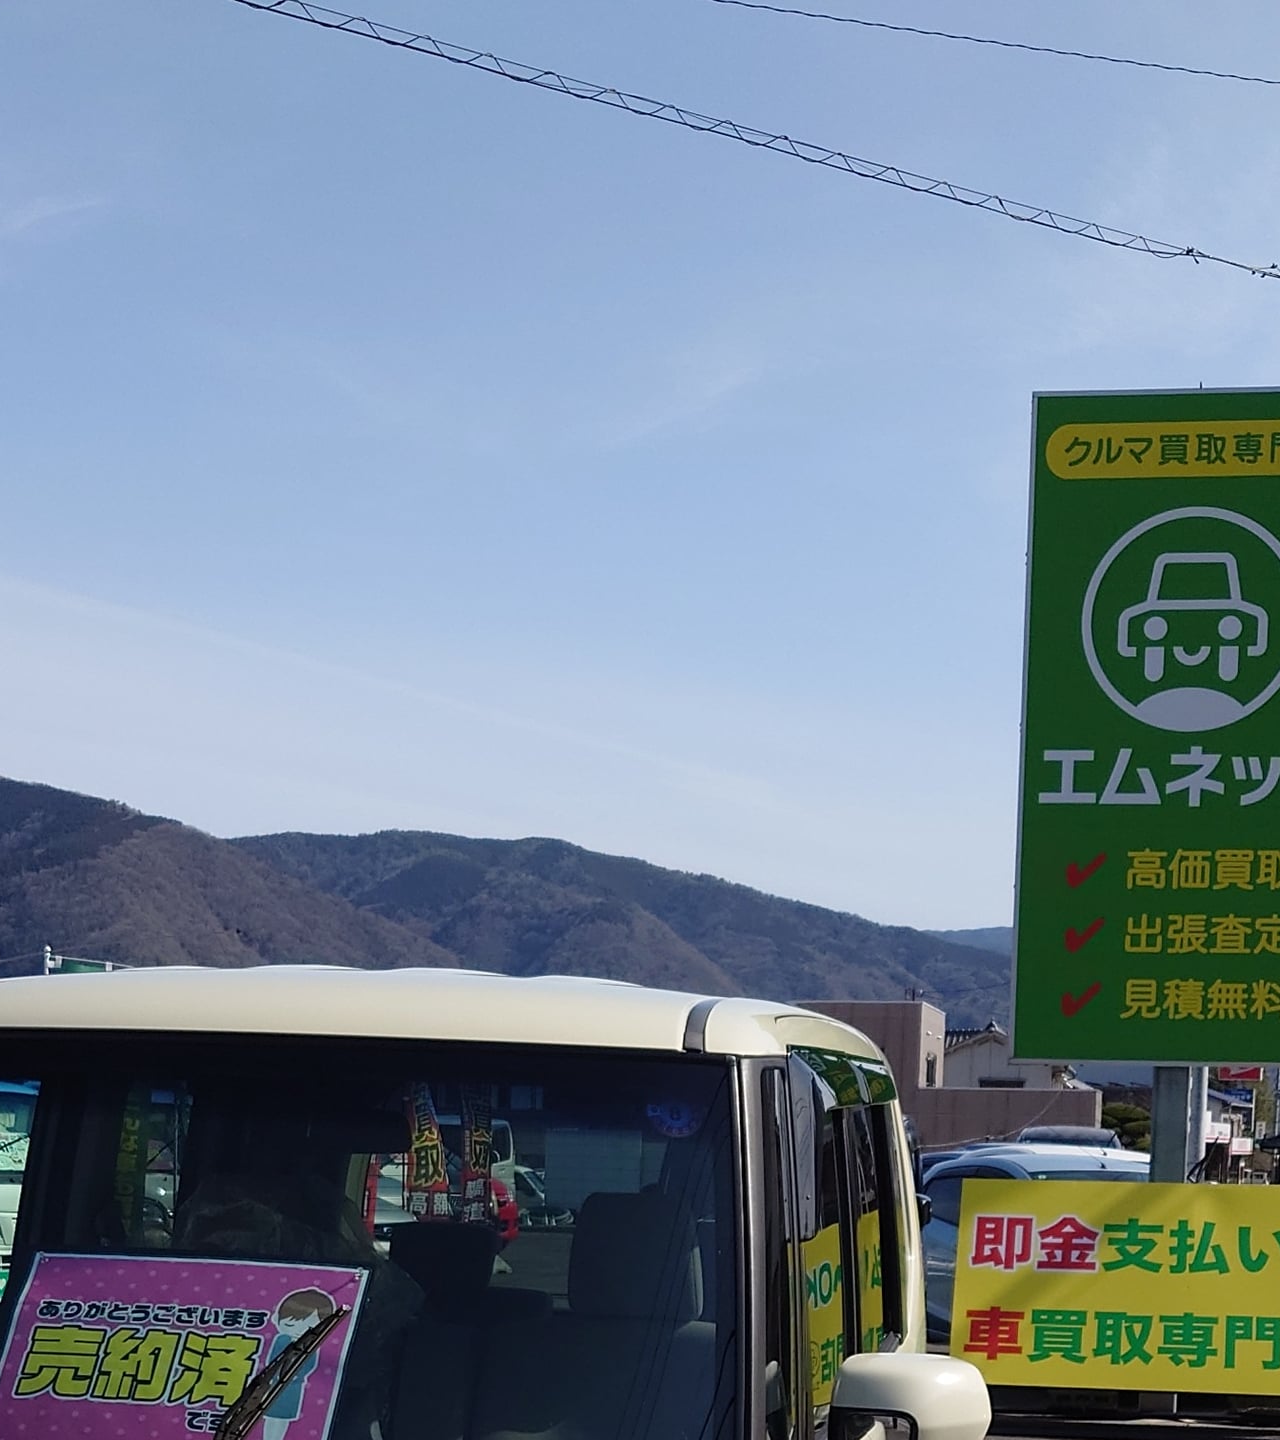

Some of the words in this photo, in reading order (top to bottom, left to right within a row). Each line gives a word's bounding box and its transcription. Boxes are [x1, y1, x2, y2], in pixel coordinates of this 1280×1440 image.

[38, 1299, 269, 1330] ありがとうございます
[13, 1324, 263, 1409] 売約済
